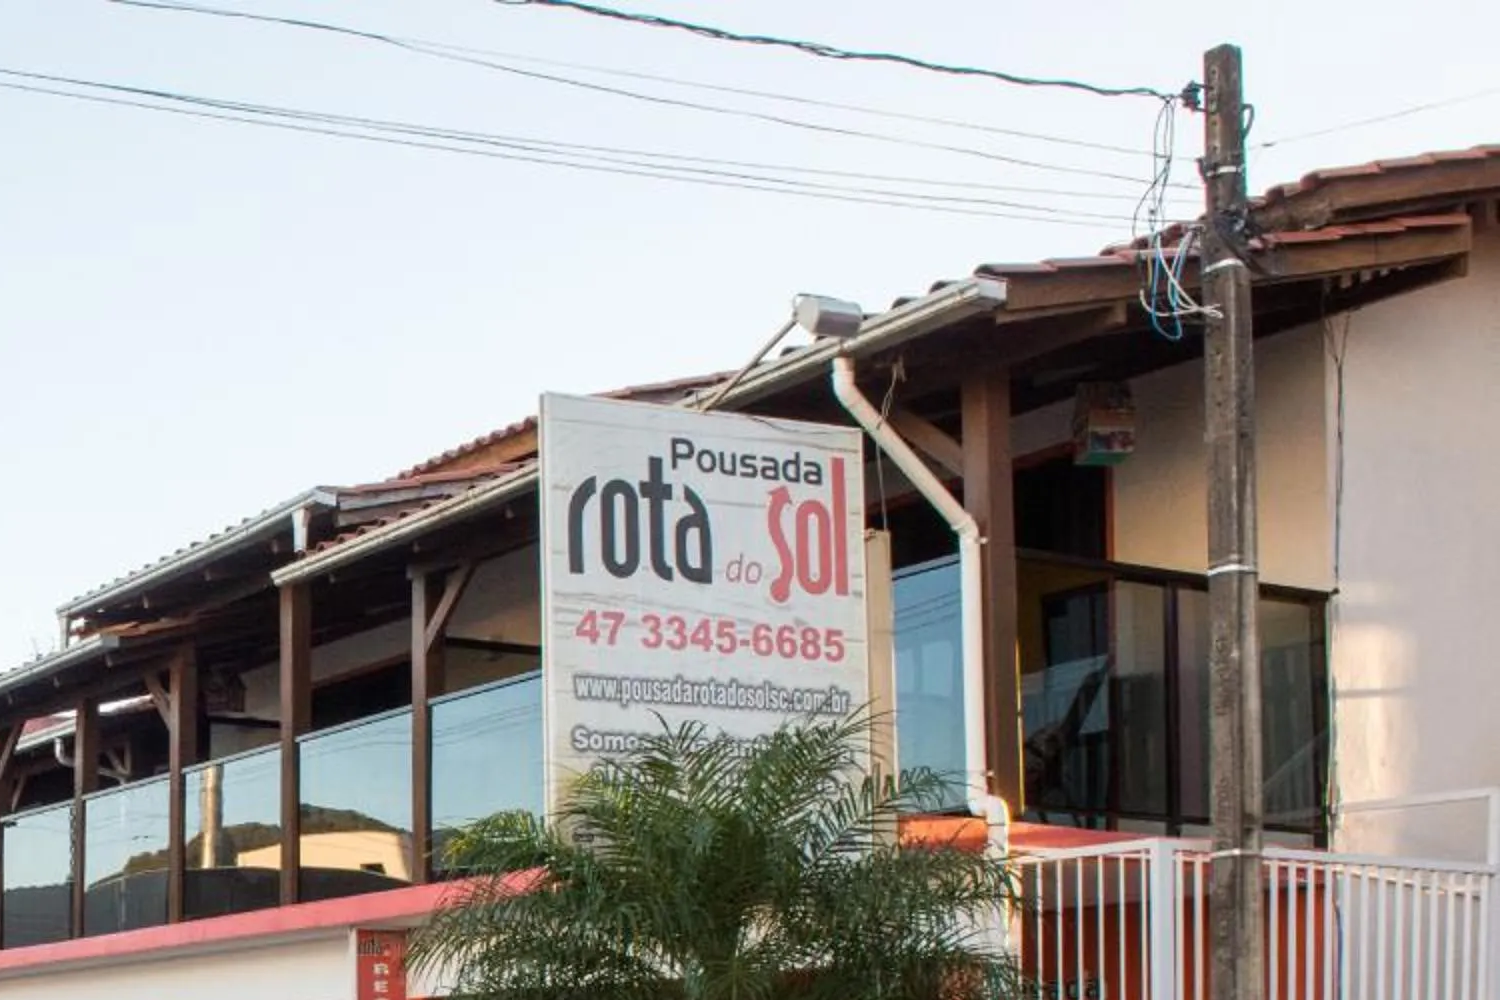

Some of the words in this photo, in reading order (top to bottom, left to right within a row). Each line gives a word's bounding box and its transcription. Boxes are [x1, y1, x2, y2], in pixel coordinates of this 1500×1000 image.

[671, 438, 822, 486] Pousada
[567, 456, 712, 584] rota
[725, 553, 762, 584] do
[575, 609, 625, 646] 47
[641, 613, 845, 663] 3345-6685
[572, 724, 650, 752] Somo
